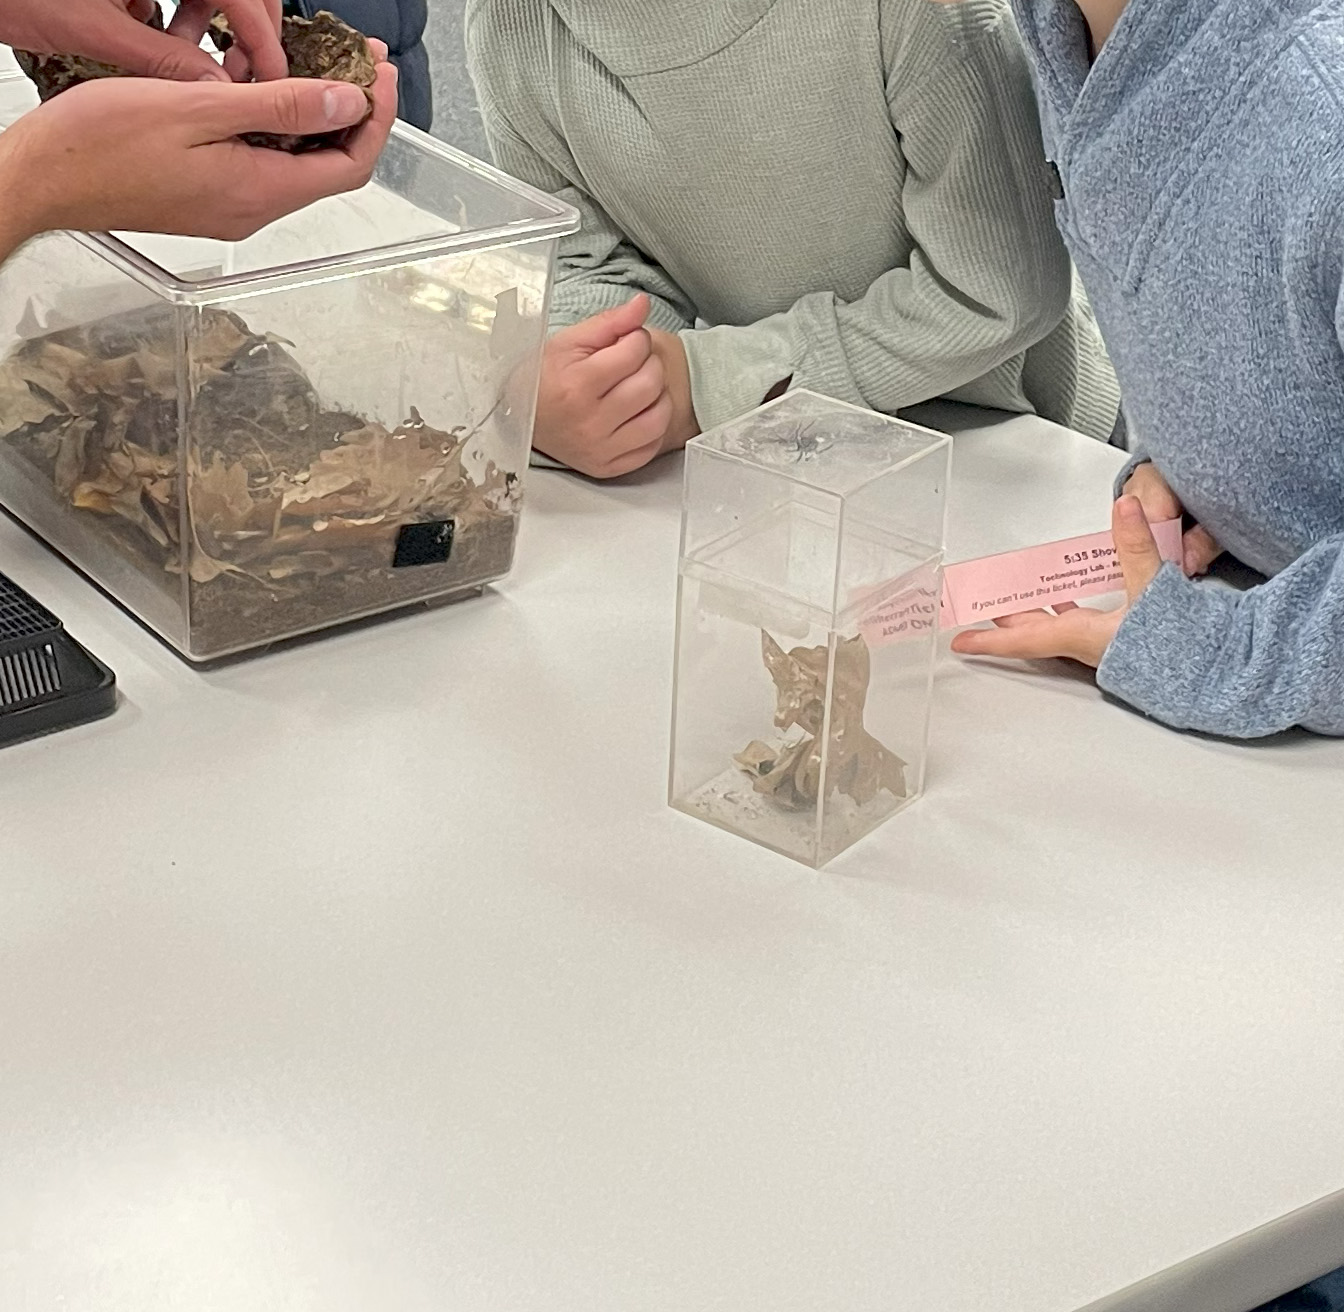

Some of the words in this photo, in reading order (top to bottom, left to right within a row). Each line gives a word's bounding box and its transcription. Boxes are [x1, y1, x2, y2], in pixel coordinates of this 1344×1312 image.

[1064, 551, 1088, 564] 5:35
[1040, 568, 1087, 583] Technology
[1090, 564, 1104, 572] Lab
[971, 601, 978, 610] If
[979, 600, 995, 611] you
[997, 593, 1018, 604] can't
[1020, 591, 1034, 599] use
[1036, 587, 1050, 596] this
[1053, 581, 1077, 592] ticket,
[1080, 575, 1105, 587] please
